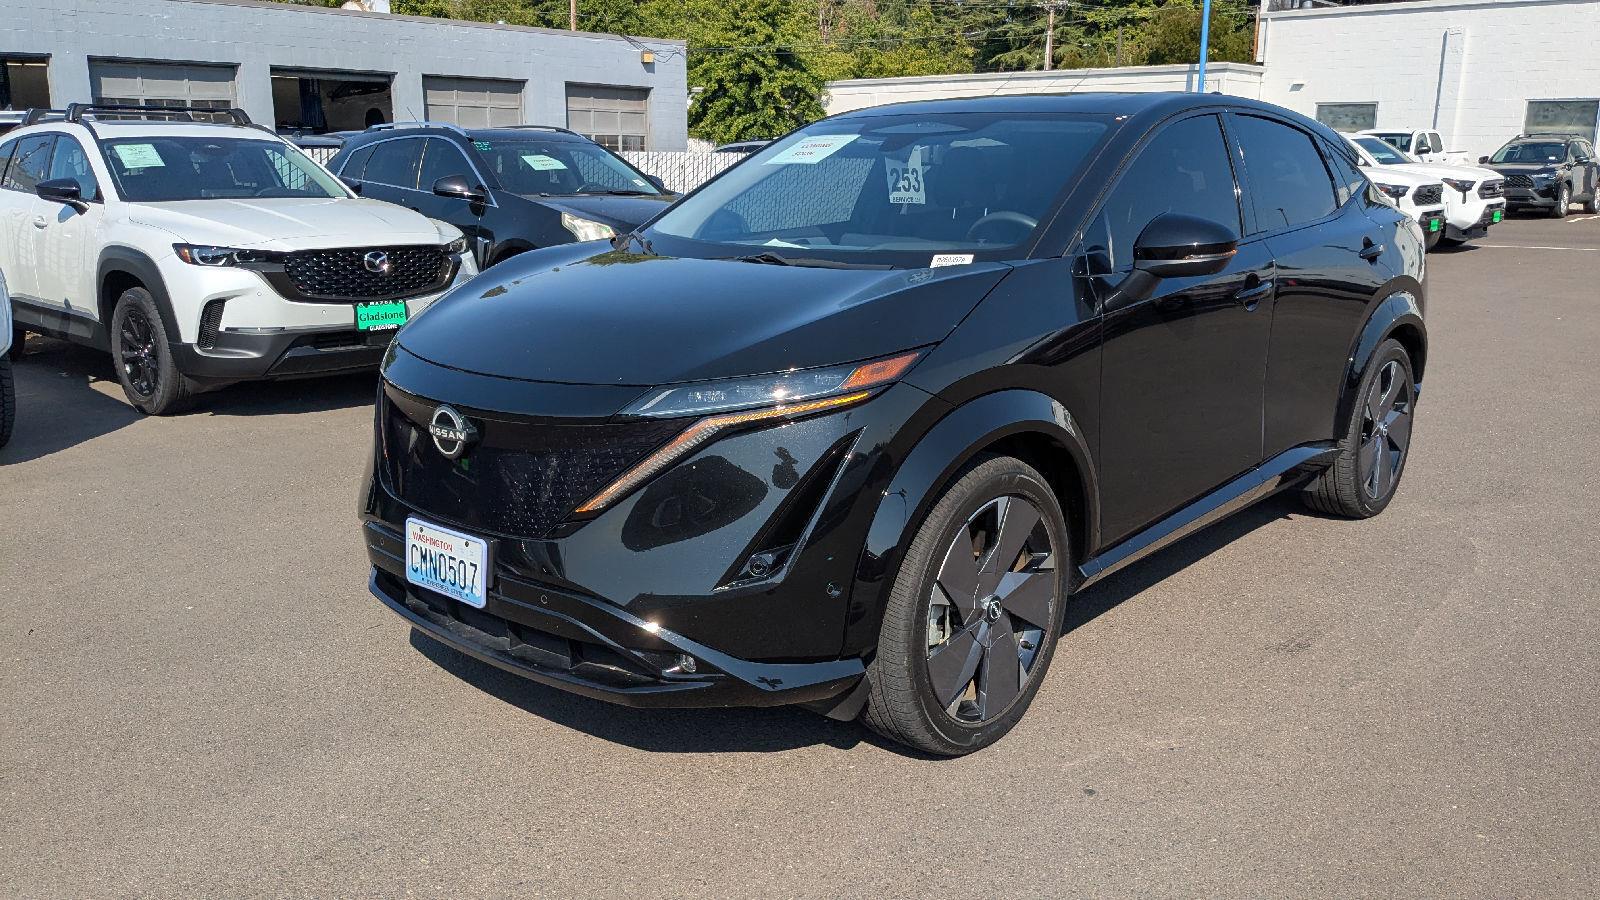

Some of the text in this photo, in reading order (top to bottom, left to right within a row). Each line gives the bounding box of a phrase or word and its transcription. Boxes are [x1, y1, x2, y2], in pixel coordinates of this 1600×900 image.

[889, 167, 921, 193] 253
[359, 311, 405, 322] Gladstone
[429, 425, 465, 440] NISSAN
[412, 531, 453, 552] WASHINGTON
[411, 543, 477, 593] CMN0507
